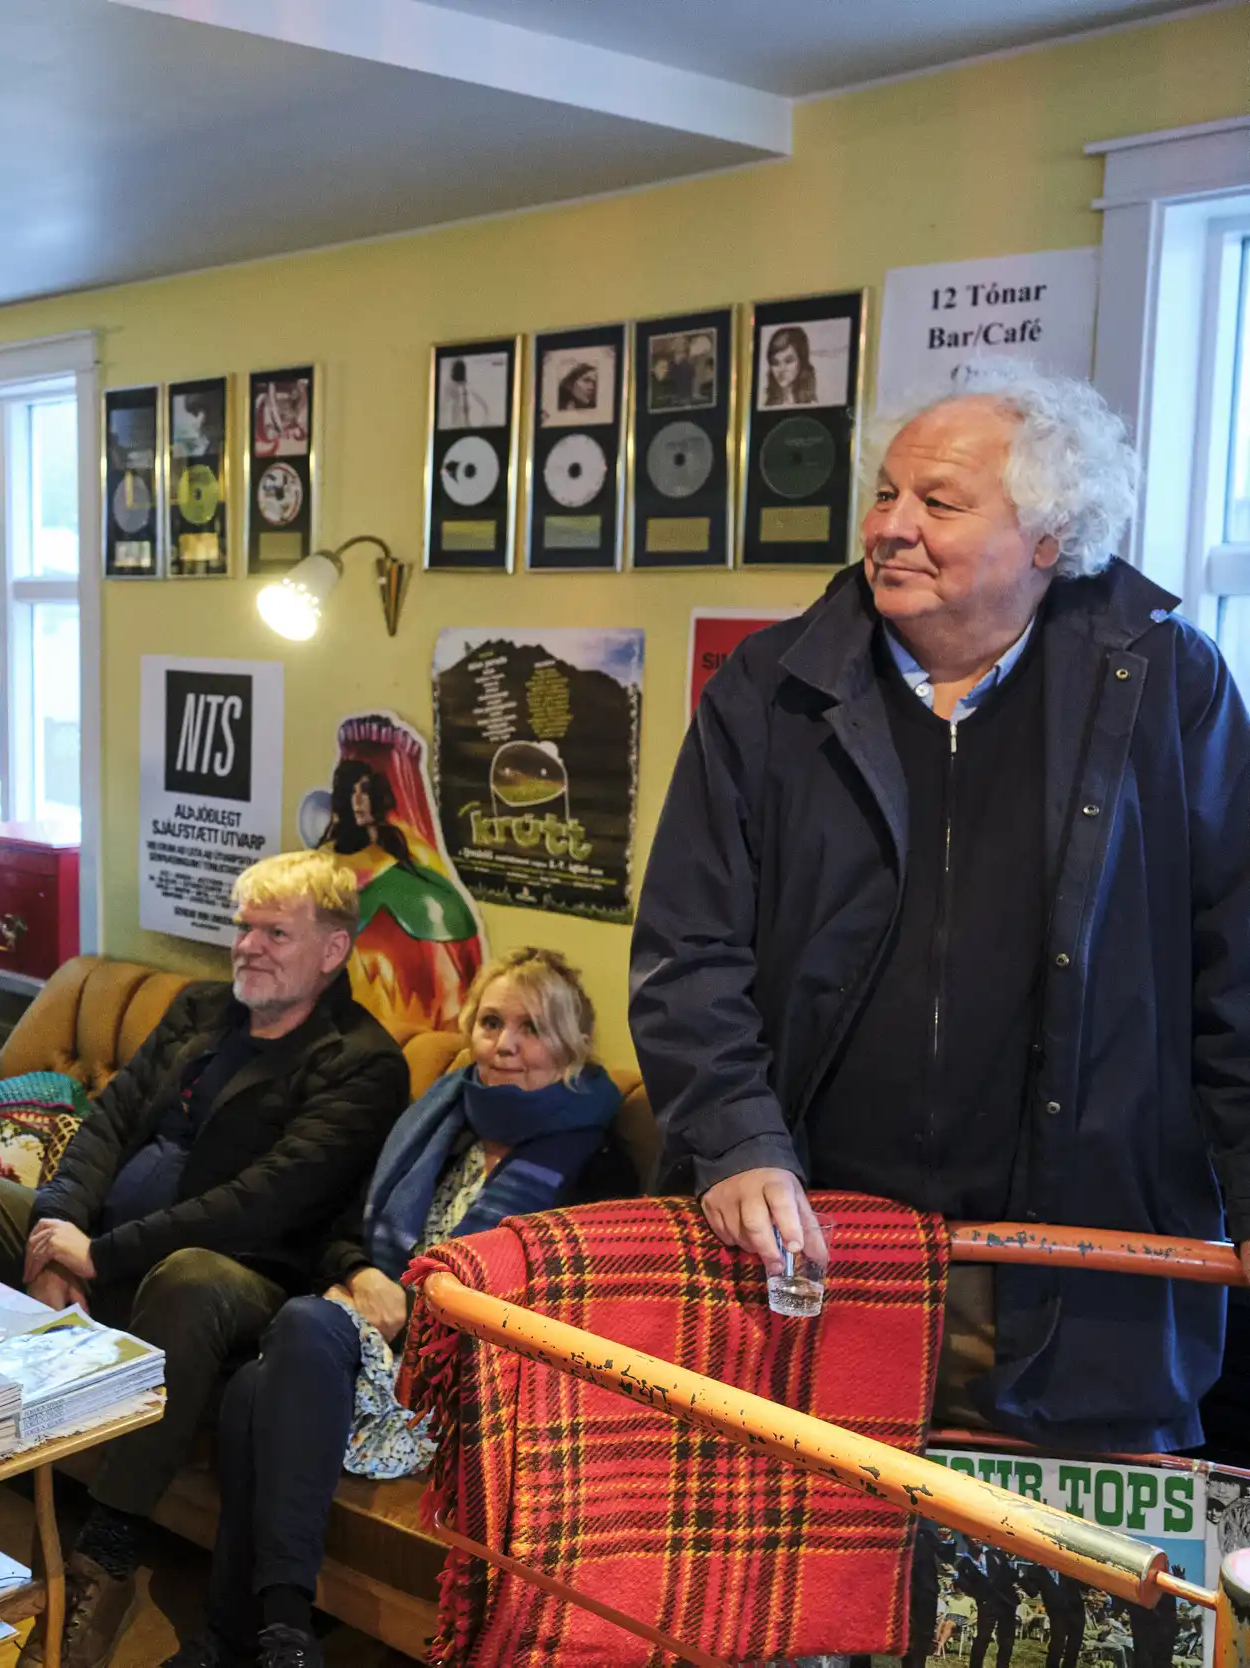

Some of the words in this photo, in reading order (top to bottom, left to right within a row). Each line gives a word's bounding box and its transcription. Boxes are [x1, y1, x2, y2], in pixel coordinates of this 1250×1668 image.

[930, 287, 958, 311] 12
[966, 281, 1048, 307] Tónar
[927, 317, 1043, 350] Bar/Café
[175, 692, 243, 778] NTS
[1059, 1464, 1195, 1533] TOPS
